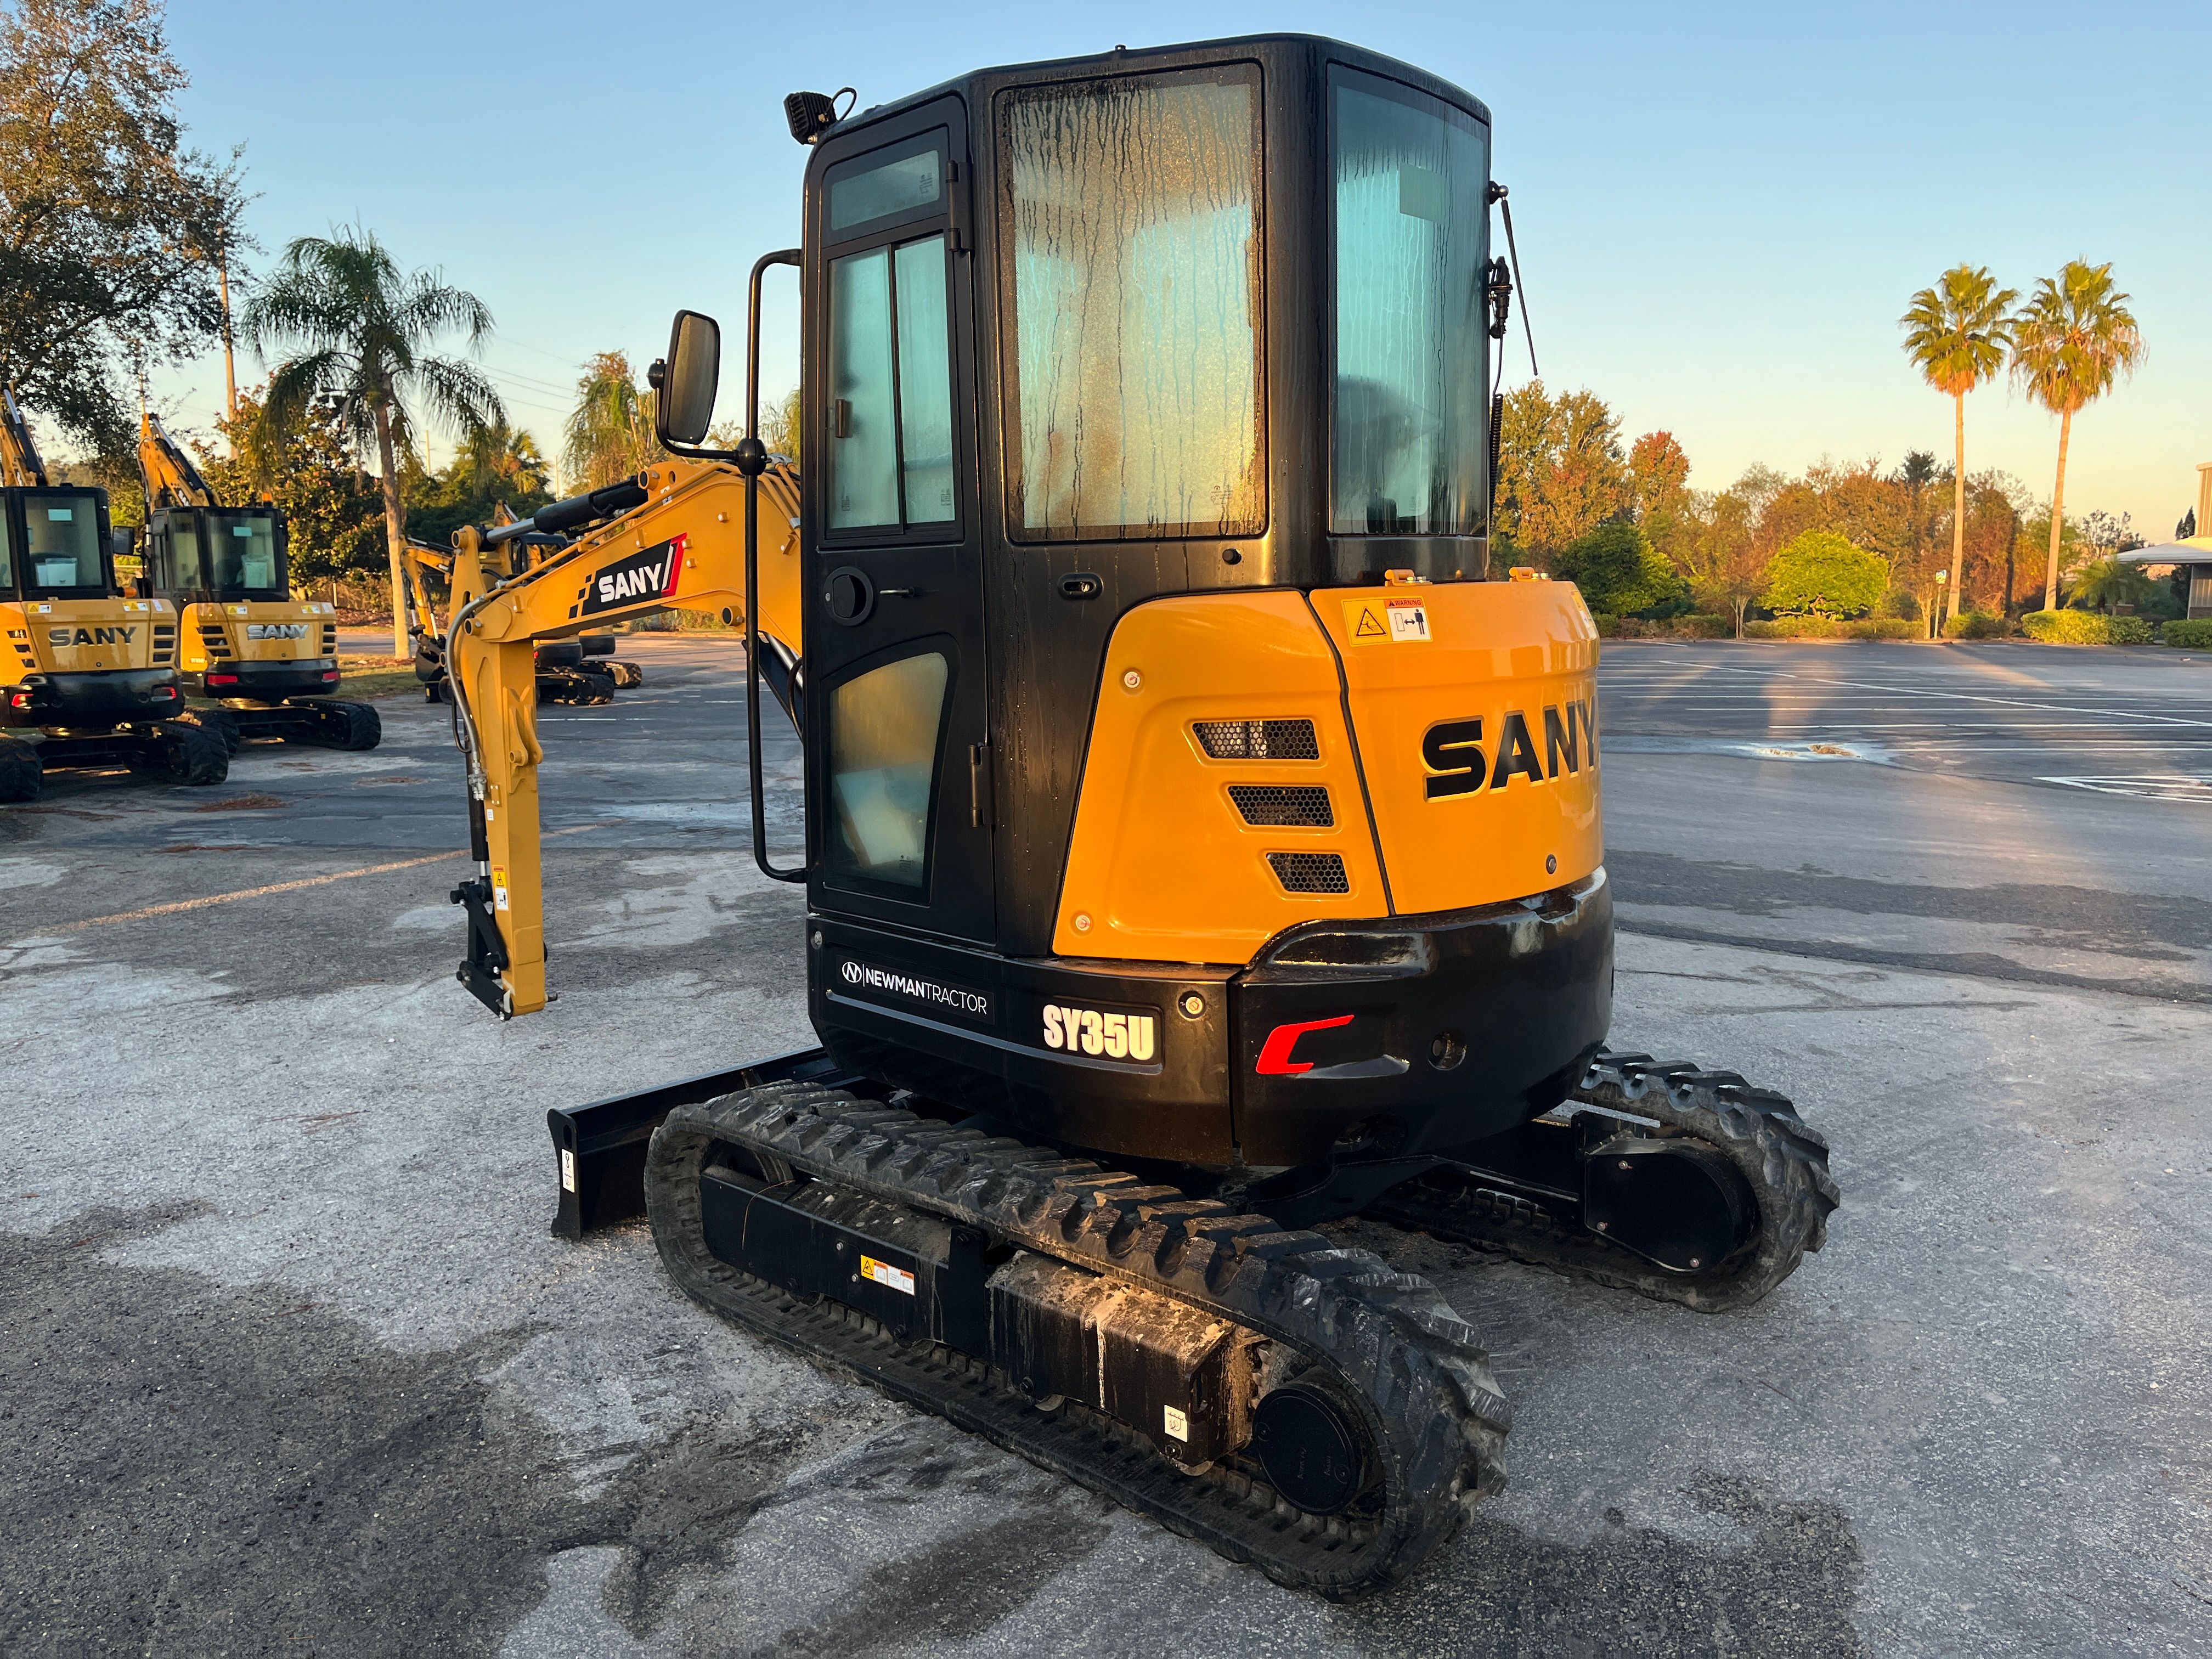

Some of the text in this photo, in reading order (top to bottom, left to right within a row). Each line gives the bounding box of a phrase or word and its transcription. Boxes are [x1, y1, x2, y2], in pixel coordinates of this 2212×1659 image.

[599, 563, 662, 602] SANY
[49, 627, 136, 647] SANY
[247, 624, 308, 639] SANY
[1421, 701, 1596, 799] SANY
[1043, 1004, 1154, 1060] SY35U
